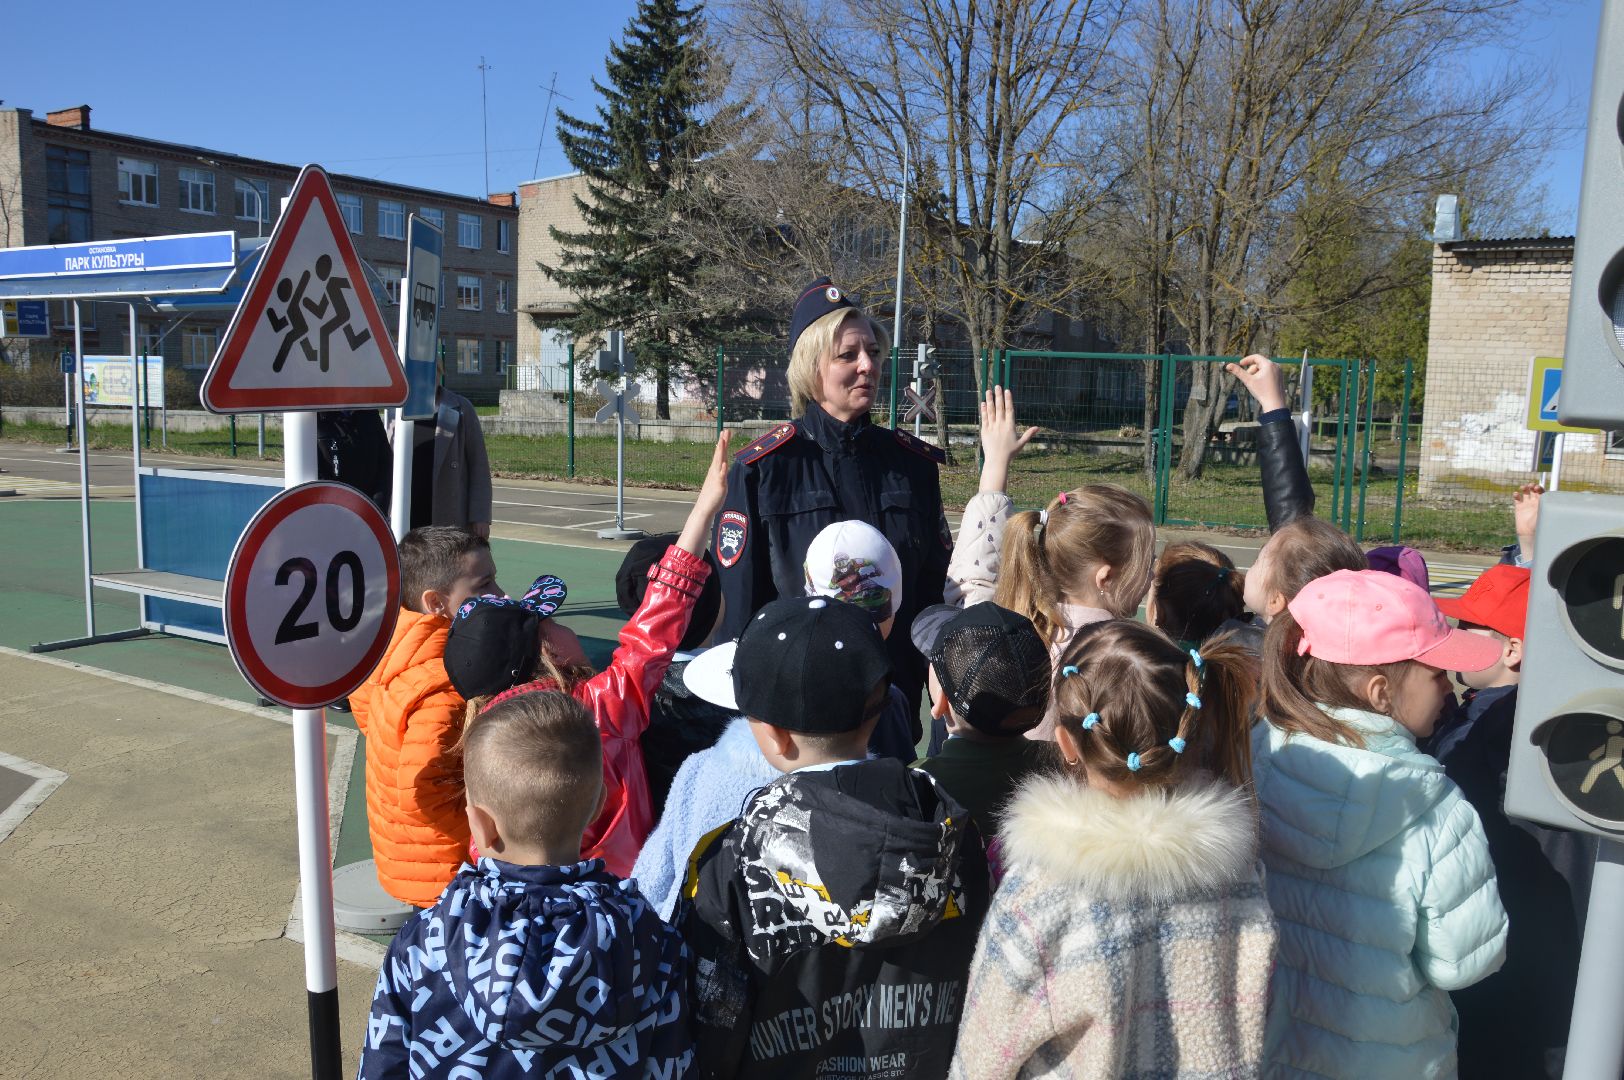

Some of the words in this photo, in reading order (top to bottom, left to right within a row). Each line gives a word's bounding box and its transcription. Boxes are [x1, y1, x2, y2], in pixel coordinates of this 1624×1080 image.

[65, 257, 90, 270] ПАРК
[91, 252, 145, 269] КУЛЬТУРЫ
[88, 246, 117, 254] ОСТАНОВКА
[274, 550, 366, 646] 20
[750, 1006, 822, 1062] HUNTER
[822, 983, 875, 1042] STORY
[879, 982, 933, 1029] MEN'S
[815, 1055, 867, 1075] FASHION
[870, 1052, 906, 1072] WEAR
